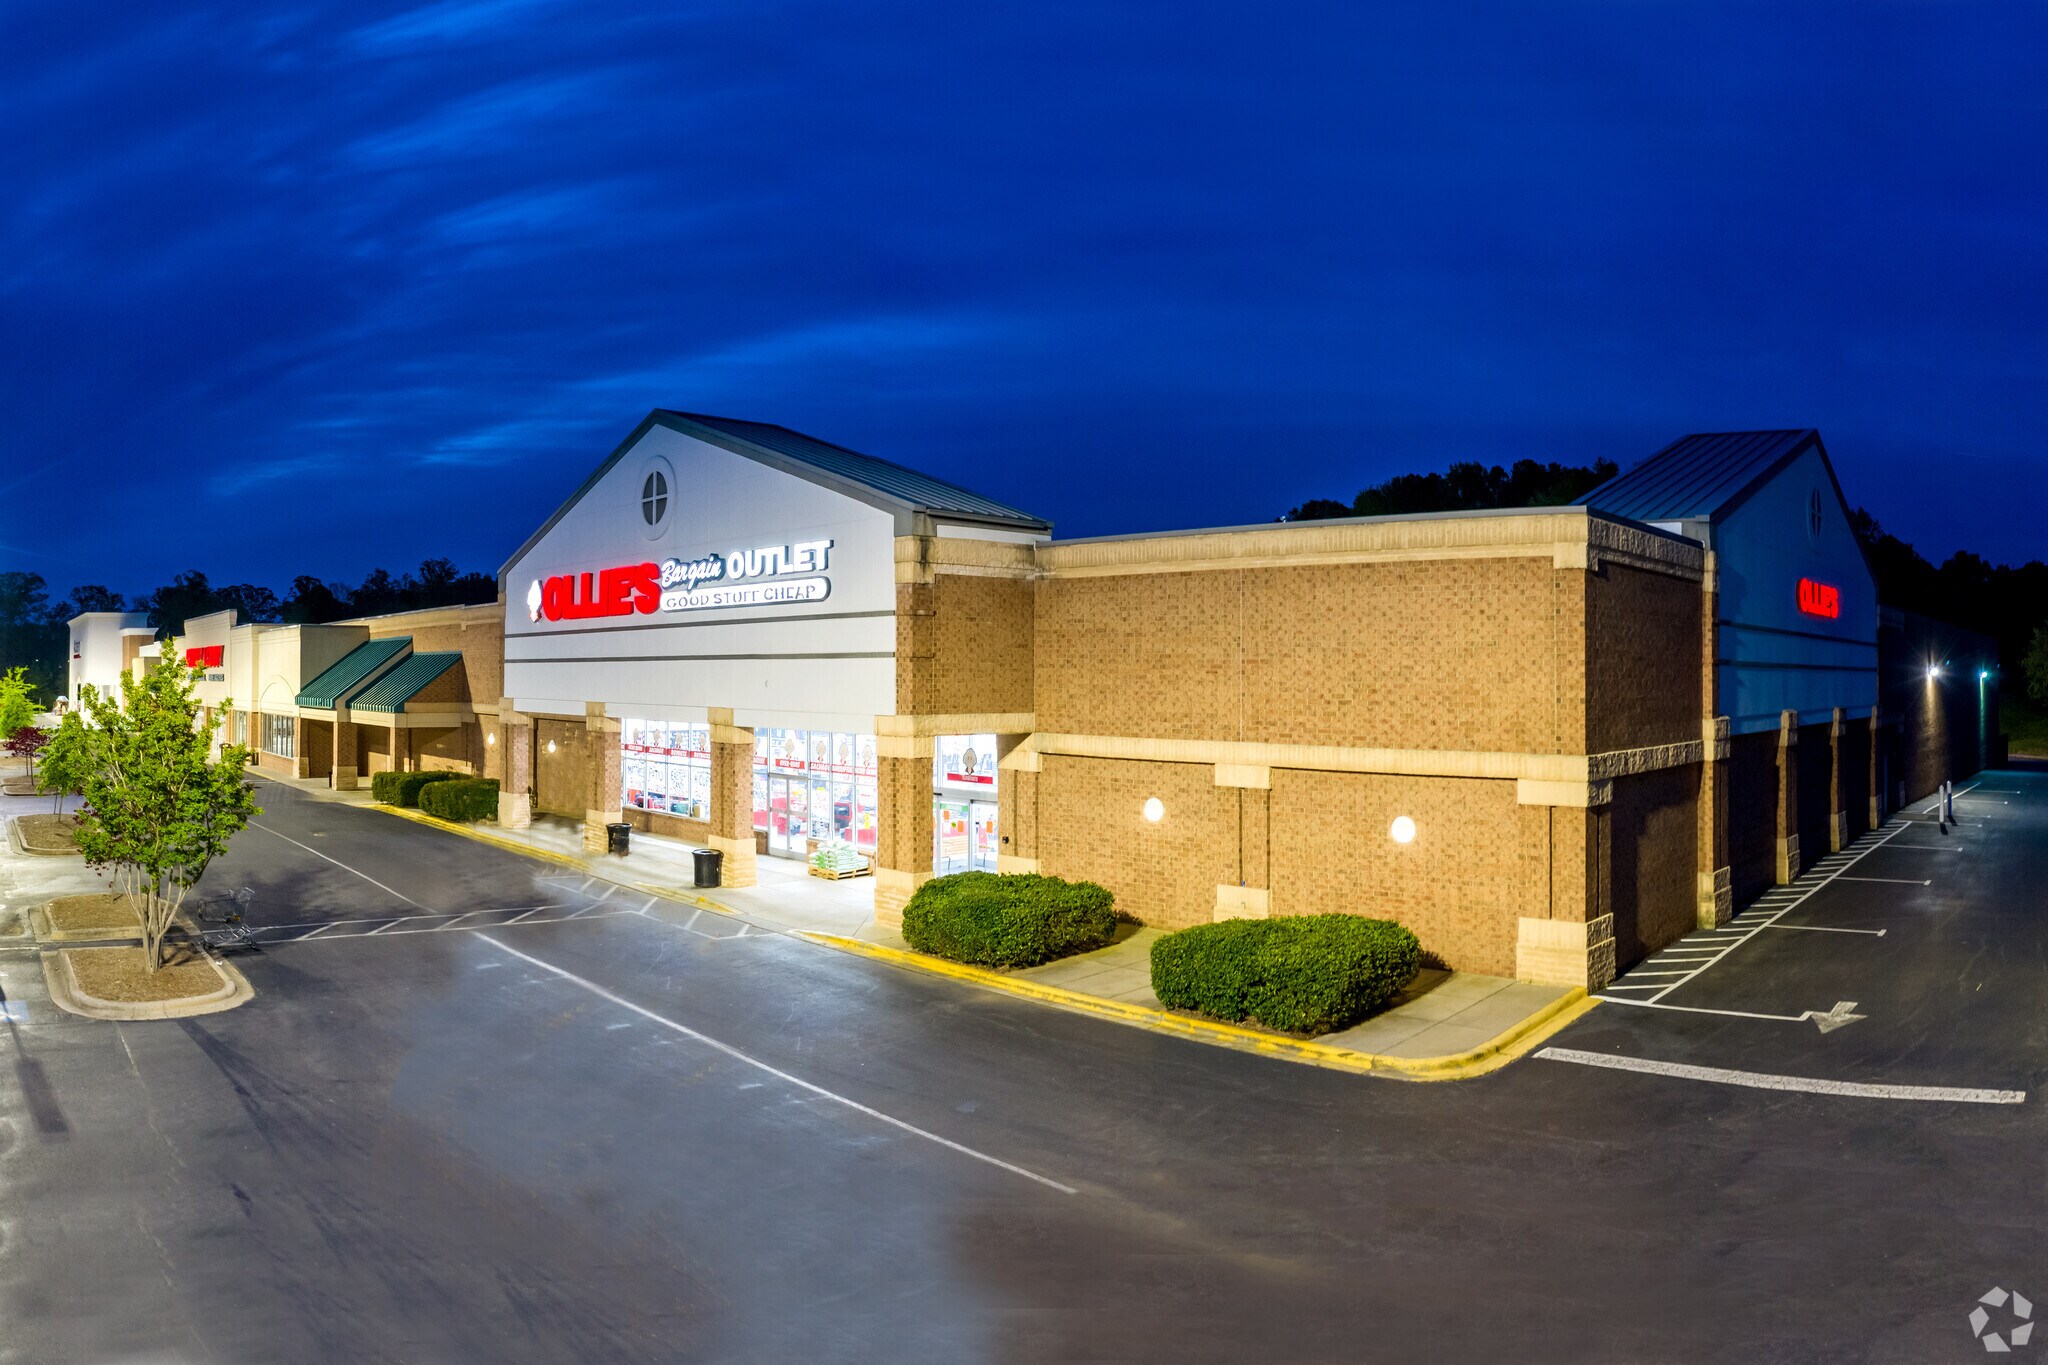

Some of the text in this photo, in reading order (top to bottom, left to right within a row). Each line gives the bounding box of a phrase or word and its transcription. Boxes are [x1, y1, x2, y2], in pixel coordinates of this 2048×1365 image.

[661, 554, 725, 591] Bargain
[726, 540, 834, 580] OUTLET
[666, 584, 816, 608] GOOD STUFF CHEAP
